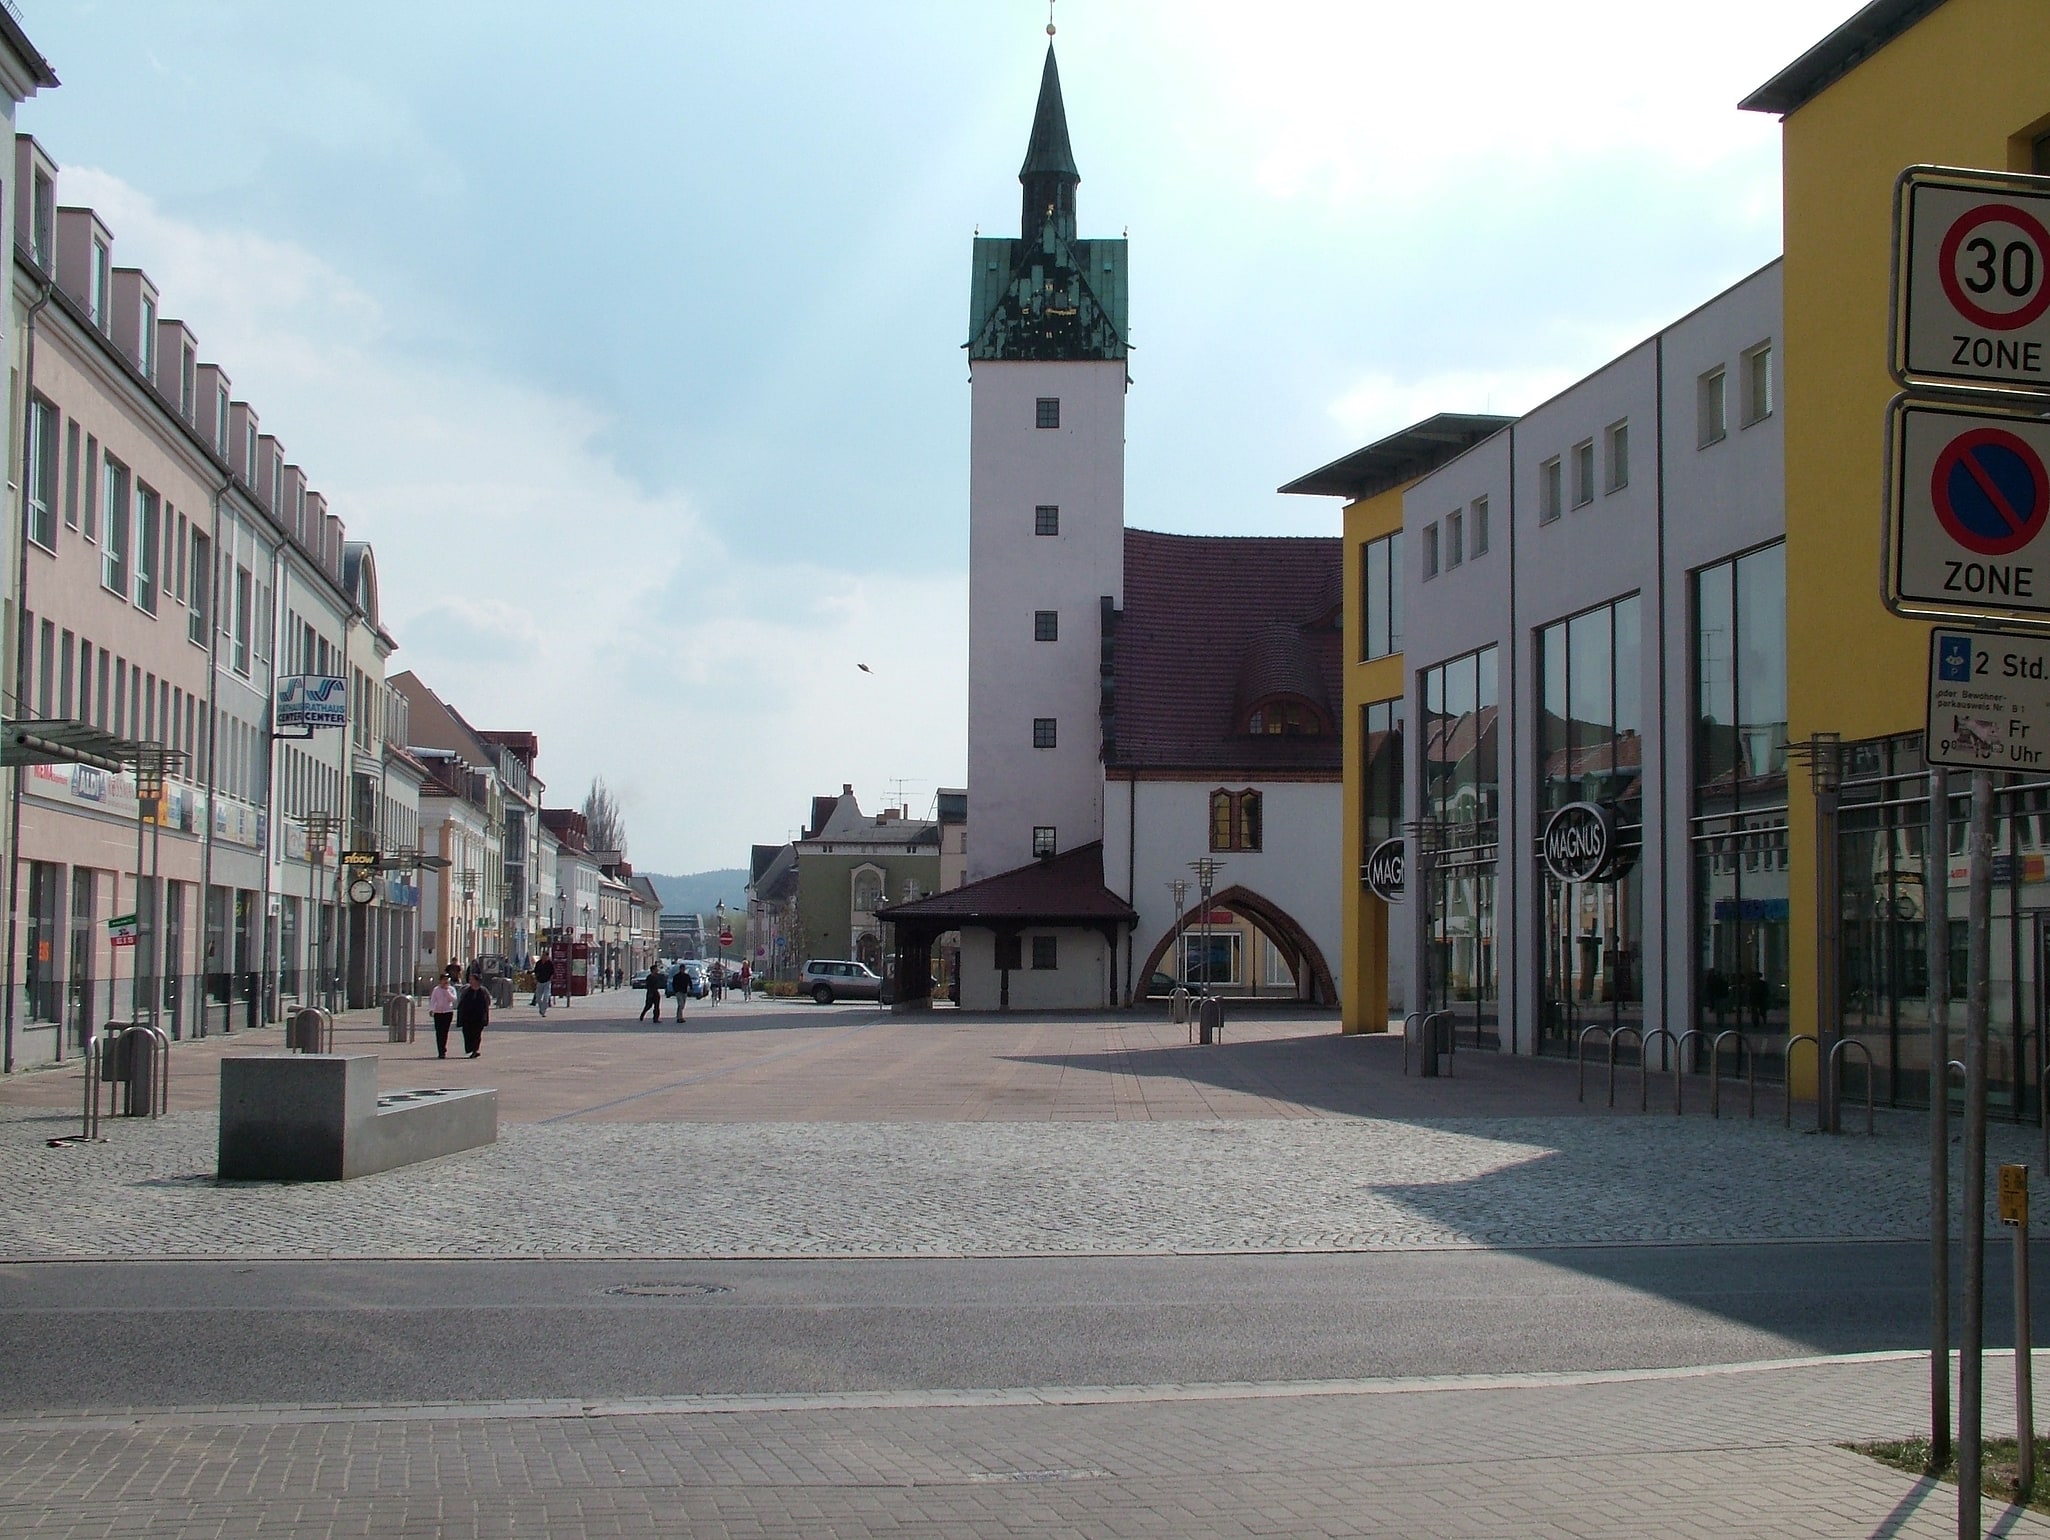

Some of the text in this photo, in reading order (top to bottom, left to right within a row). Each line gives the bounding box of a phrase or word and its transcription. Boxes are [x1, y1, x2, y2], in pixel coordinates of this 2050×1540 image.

[1965, 237, 2034, 297] 30
[1952, 335, 2042, 372] ZONE
[1943, 561, 2033, 597] ZONE
[1975, 651, 2049, 680] 2 Std.
[305, 702, 345, 713] RATHAUS
[305, 712, 345, 723] CENTER
[2009, 719, 2030, 738] Fr
[2010, 744, 2042, 763] Uhr
[79, 770, 100, 797] ALDI
[1549, 823, 1600, 860] MAGNUS
